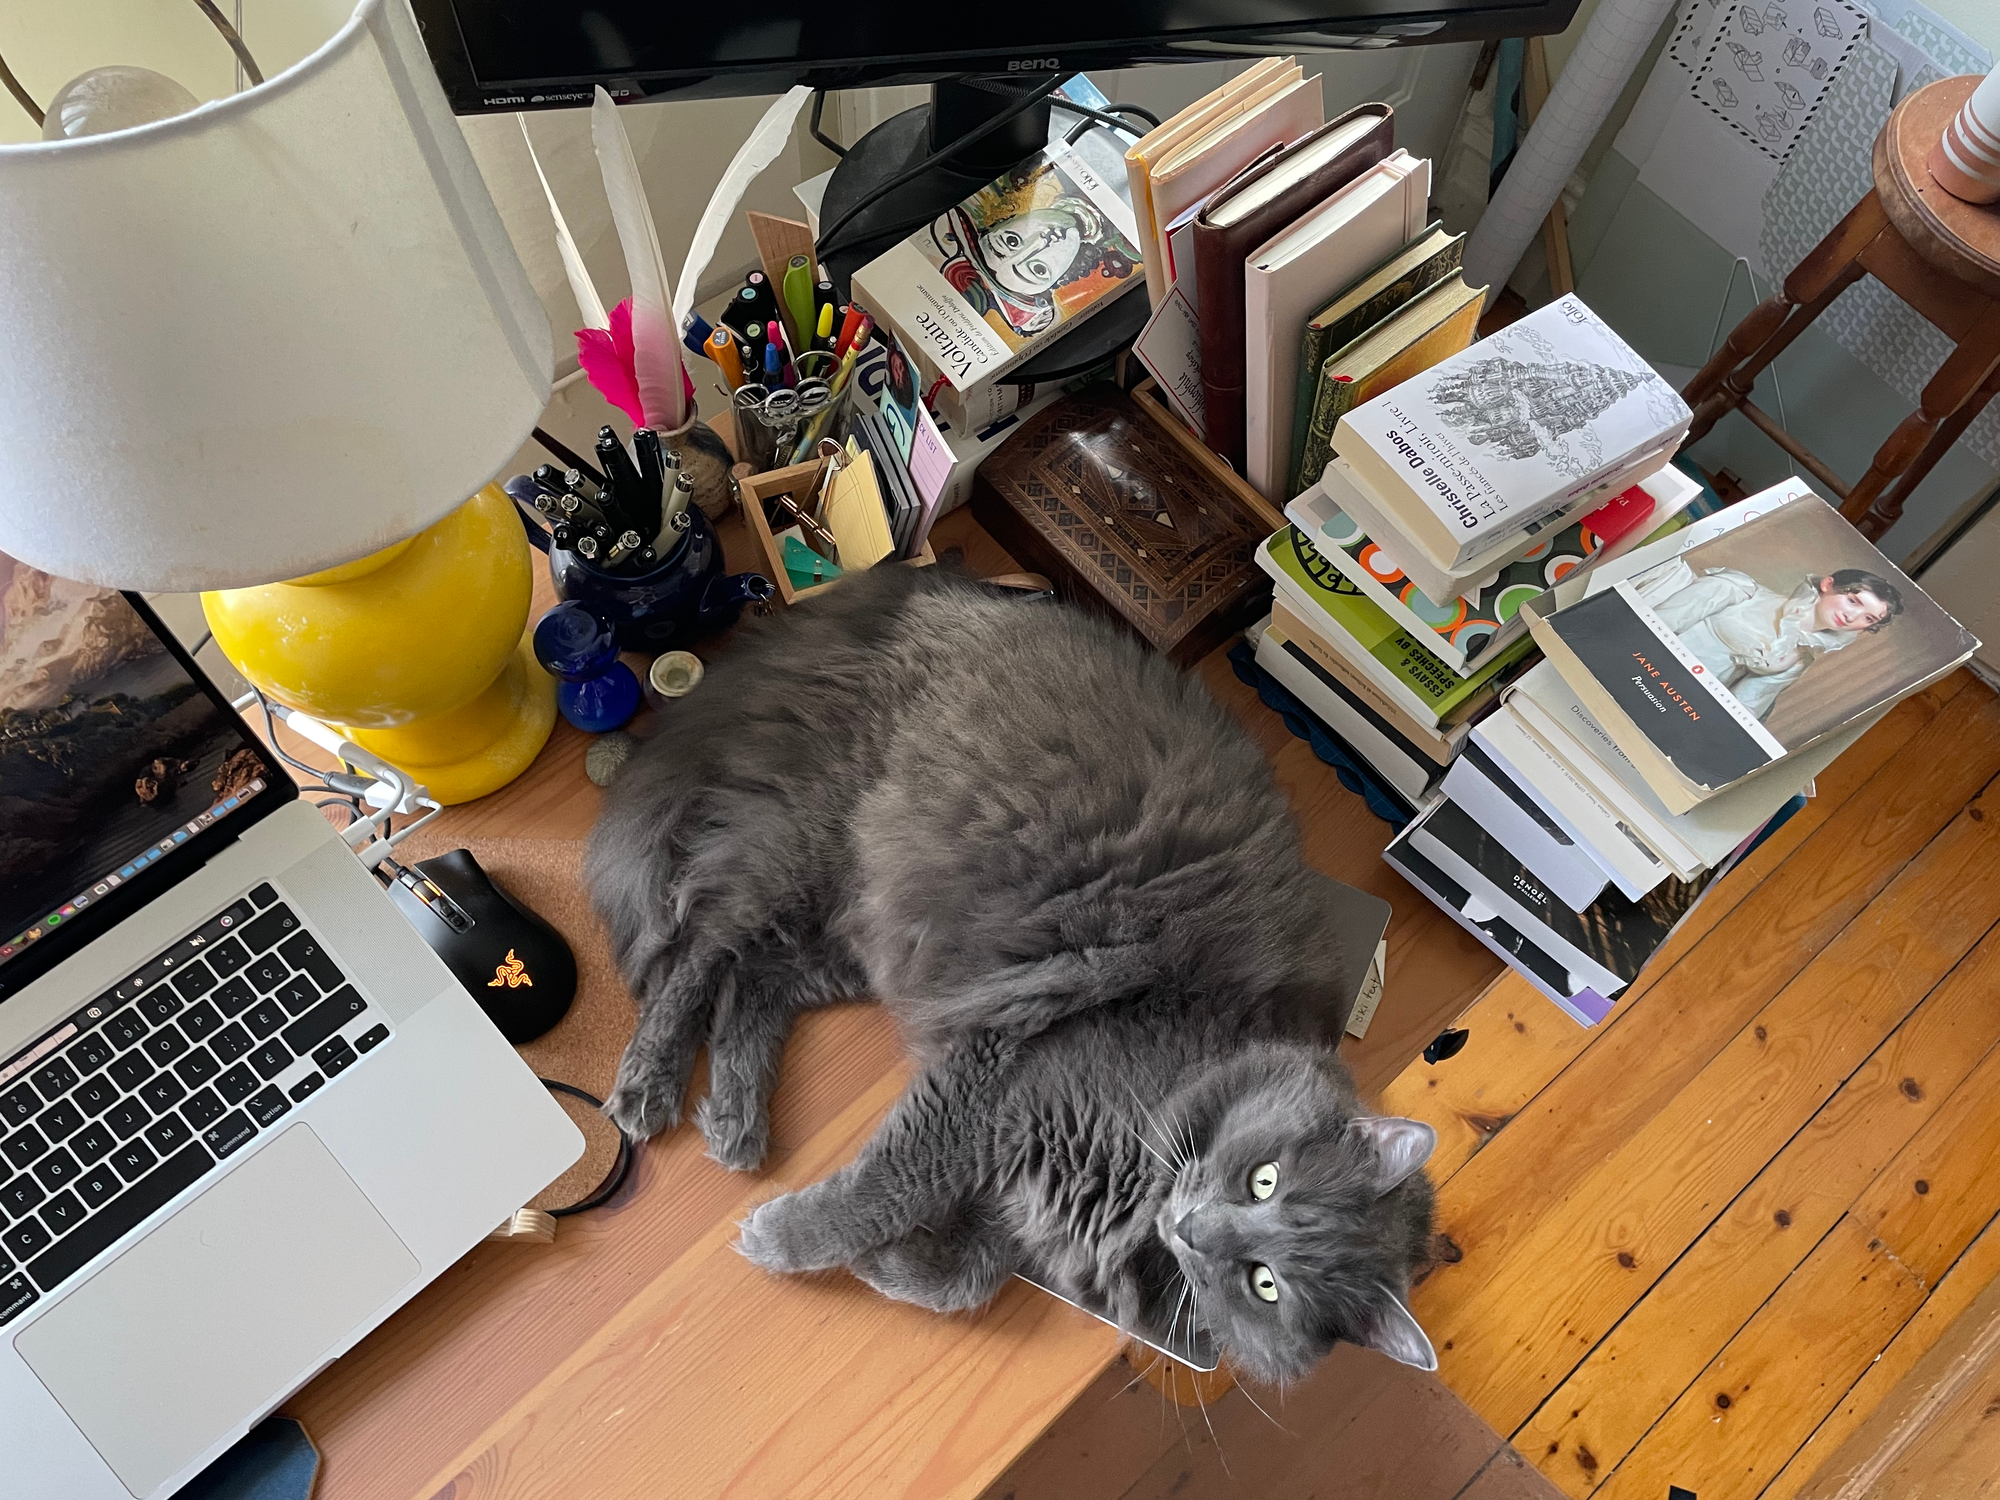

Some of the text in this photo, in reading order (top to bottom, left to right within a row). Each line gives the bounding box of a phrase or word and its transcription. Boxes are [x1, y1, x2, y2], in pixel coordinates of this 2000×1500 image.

[1007, 57, 1060, 71] BenQ
[483, 95, 525, 105] HDMI
[1079, 169, 1099, 192] folio
[915, 283, 989, 365] Candide ou l'Optimisme
[973, 329, 983, 337] de
[913, 309, 972, 379] Voltaire
[987, 387, 992, 396] TO
[1387, 404, 1418, 434] Livre
[924, 434, 937, 454] LIST
[1418, 431, 1481, 502] Passe-miroir,
[1433, 429, 1509, 511] Les fiancés de l'hiver
[1384, 428, 1478, 530] Christelle Dabos
[1479, 499, 1497, 519] La
[1394, 637, 1411, 649] BY
[1409, 648, 1454, 688] SPEECHES
[1645, 613, 1753, 727] PENGUIN CLASSICS
[1400, 656, 1444, 697] ESSAYS &
[1631, 652, 1701, 722] JANE AUSTEN
[1631, 674, 1667, 713] Persuasion
[1570, 704, 1613, 746] Discoveries
[1512, 874, 1546, 903] DENOËL
[159, 1005, 167, 1013] 0
[194, 1017, 202, 1026] P
[124, 1029, 133, 1038] 9
[160, 1041, 170, 1050] O
[89, 1054, 98, 1063] 8
[52, 1079, 60, 1088] 7
[90, 1090, 100, 1100] U
[157, 1088, 167, 1098] K
[18, 1105, 27, 1113] 6
[261, 1103, 283, 1121] option
[54, 1116, 63, 1125] Y
[125, 1113, 132, 1122] J
[162, 1128, 174, 1139] M
[86, 1138, 98, 1150] H
[219, 1127, 250, 1152] command
[18, 1142, 27, 1151] T
[127, 1155, 139, 1166] N
[51, 1165, 61, 1174] G
[92, 1181, 103, 1191] B
[15, 1191, 24, 1201] F
[56, 1208, 66, 1216] V
[21, 1234, 32, 1243] C
[0, 1292, 31, 1319] command
